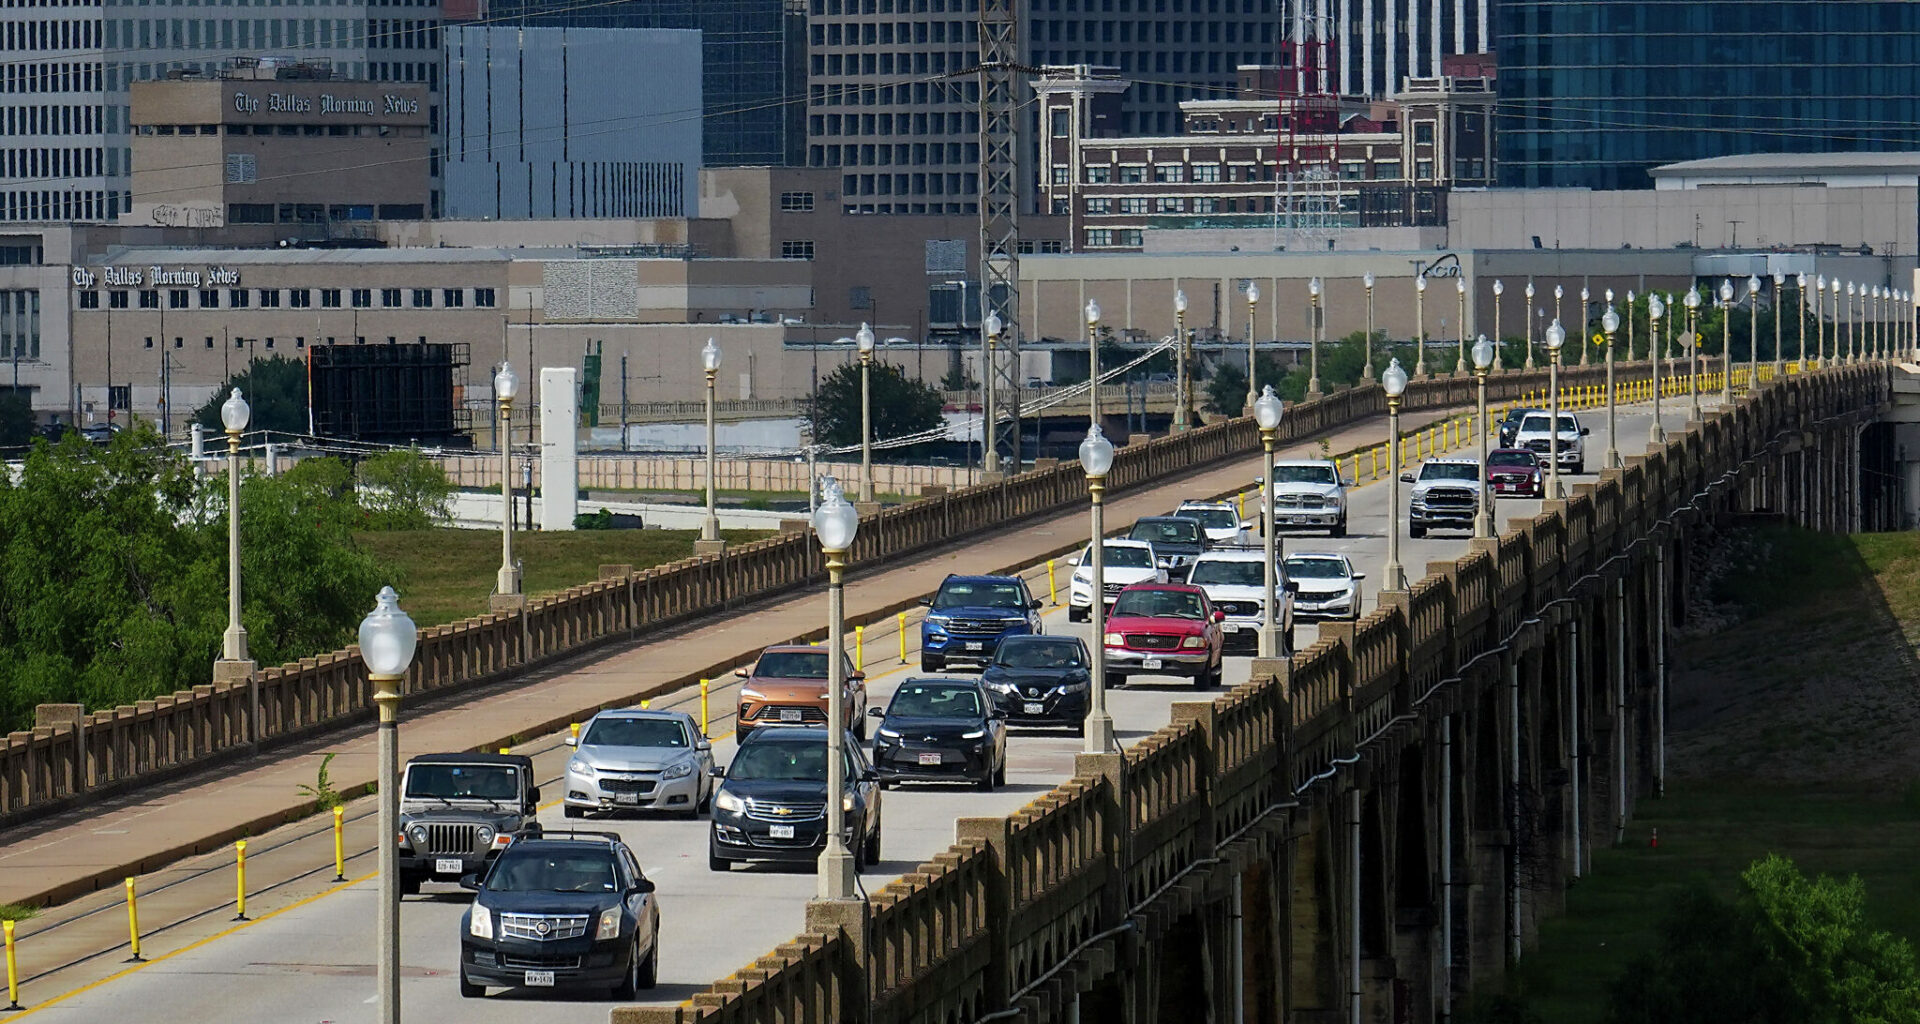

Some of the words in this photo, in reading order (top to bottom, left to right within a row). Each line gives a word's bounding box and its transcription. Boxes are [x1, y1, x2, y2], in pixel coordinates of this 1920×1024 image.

[234, 92, 259, 115] The
[268, 93, 312, 114] Dallas
[320, 94, 374, 116] Morning
[383, 94, 418, 115] News
[73, 266, 96, 289] The
[104, 266, 144, 288] Dallas
[150, 266, 200, 288] Morning
[207, 265, 240, 288] News
